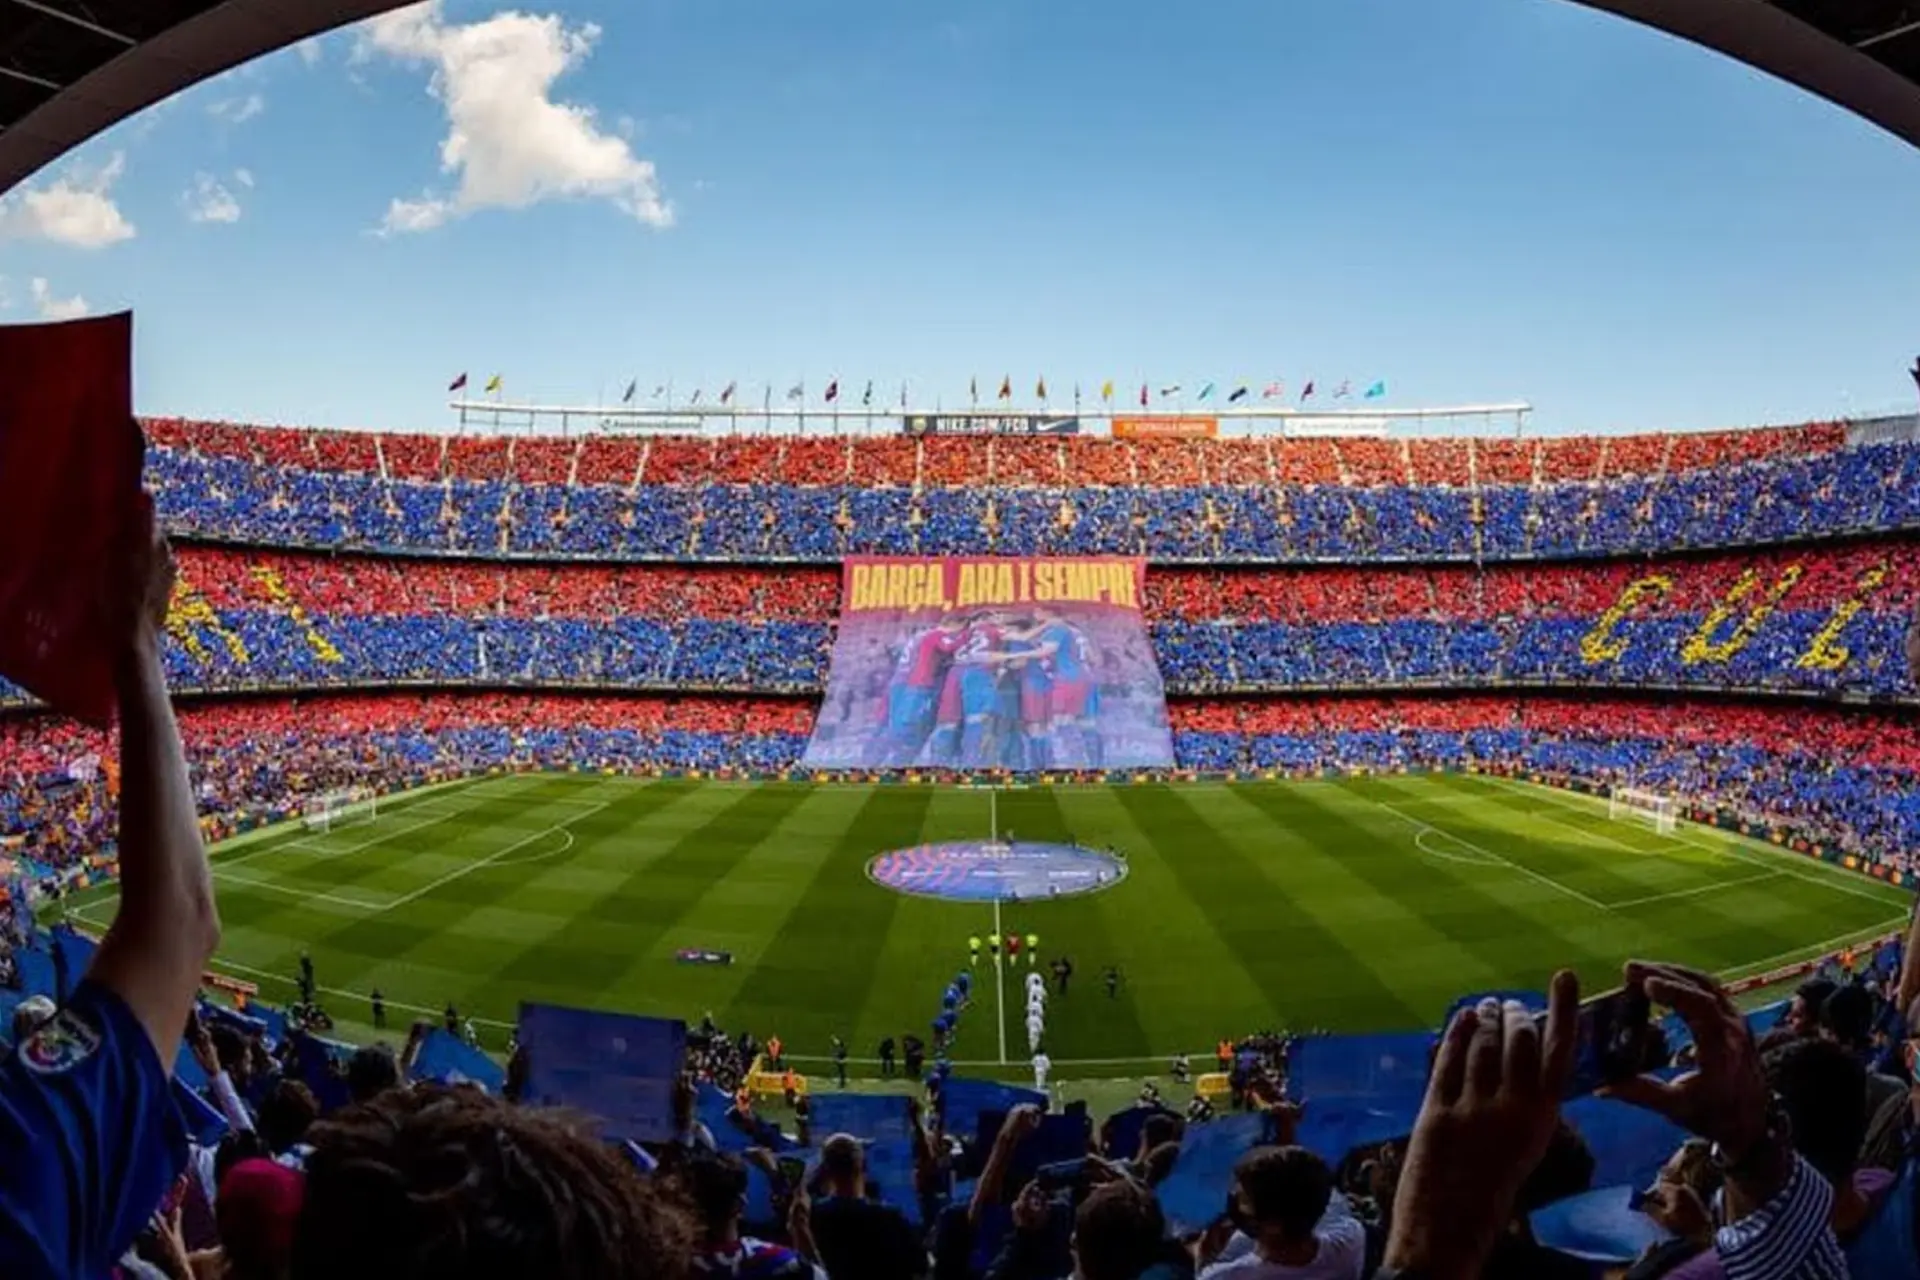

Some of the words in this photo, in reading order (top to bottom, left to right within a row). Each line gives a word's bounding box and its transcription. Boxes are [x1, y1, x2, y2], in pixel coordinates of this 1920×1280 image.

[850, 563, 953, 614] BARÇA,
[957, 563, 1014, 607] ARA
[1019, 562, 1030, 602] I
